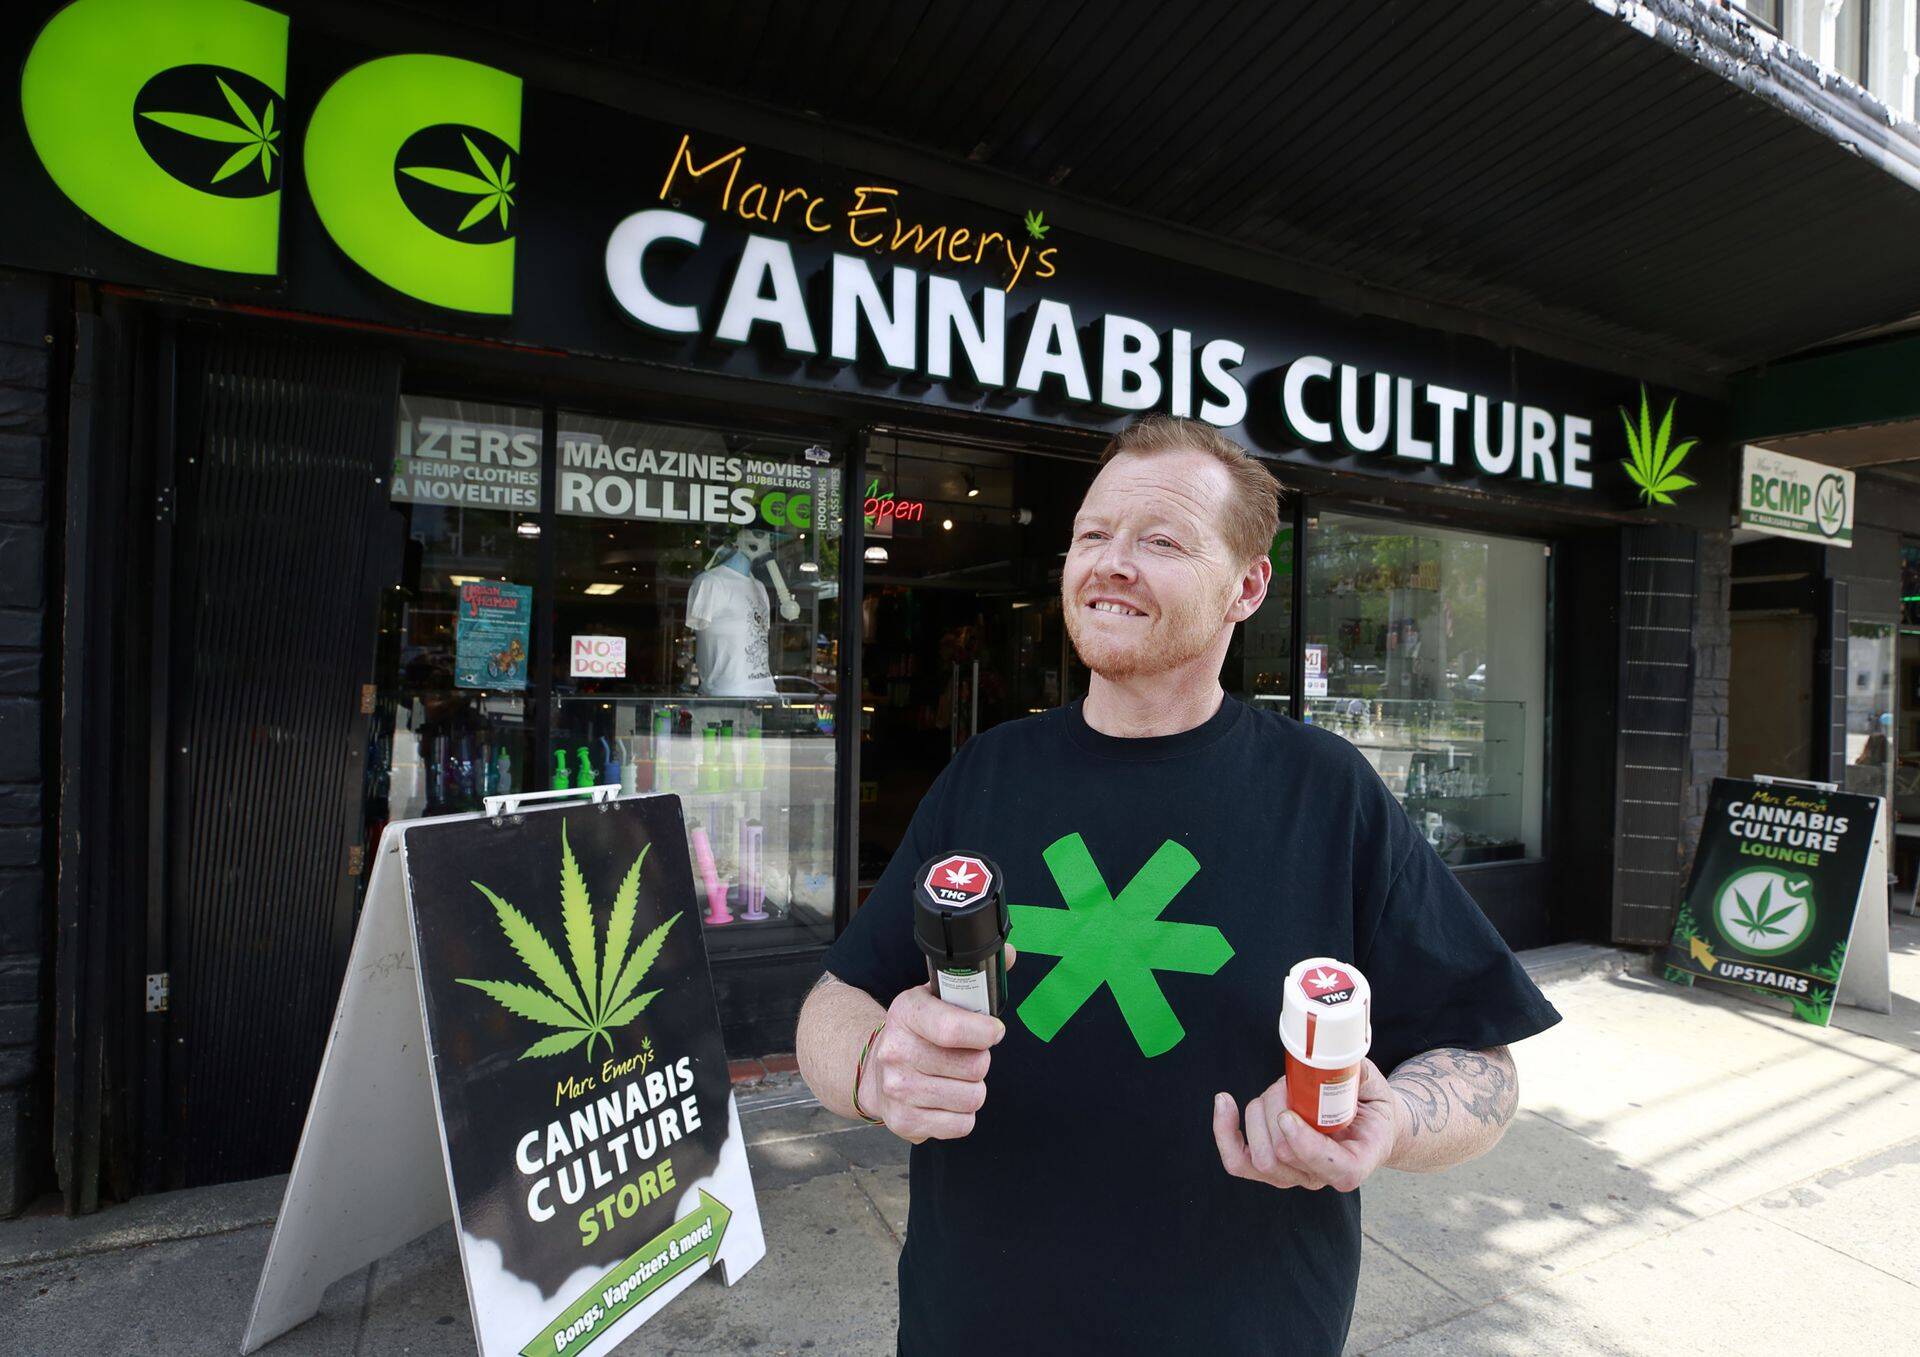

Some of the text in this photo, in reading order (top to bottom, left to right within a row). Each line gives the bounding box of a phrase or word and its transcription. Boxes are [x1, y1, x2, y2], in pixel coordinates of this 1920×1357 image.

[661, 134, 832, 232] Marc
[605, 208, 1594, 490] CANNABIS CULTURE
[400, 419, 538, 468] IZERS
[408, 460, 539, 486] HEMP CLOTHES
[563, 440, 743, 483] MAGAZINES
[746, 459, 812, 479] MOVIES
[413, 479, 538, 507] NOVELTIES
[746, 474, 812, 490] BUBBLE BAGS
[1750, 473, 1812, 516] BCMP
[561, 472, 757, 526] ROLLIES
[817, 477, 828, 531] HOOKAHS
[864, 498, 923, 527] open
[575, 640, 611, 657] NO
[575, 659, 627, 678] DOGS
[1727, 801, 1850, 834] CANNABIS
[1729, 820, 1840, 853] CULTURE
[1740, 841, 1821, 867] LOUNGE
[939, 888, 967, 901] THC
[1719, 963, 1810, 993] UPSTAIRS
[1322, 993, 1349, 1004] THC
[555, 1077, 596, 1107] Marc
[515, 1056, 695, 1175] CANNABIS
[527, 1094, 702, 1223] CULTURE
[578, 1158, 676, 1247] STORE
[554, 1217, 713, 1352] Bongs, Vaporizers & more!
